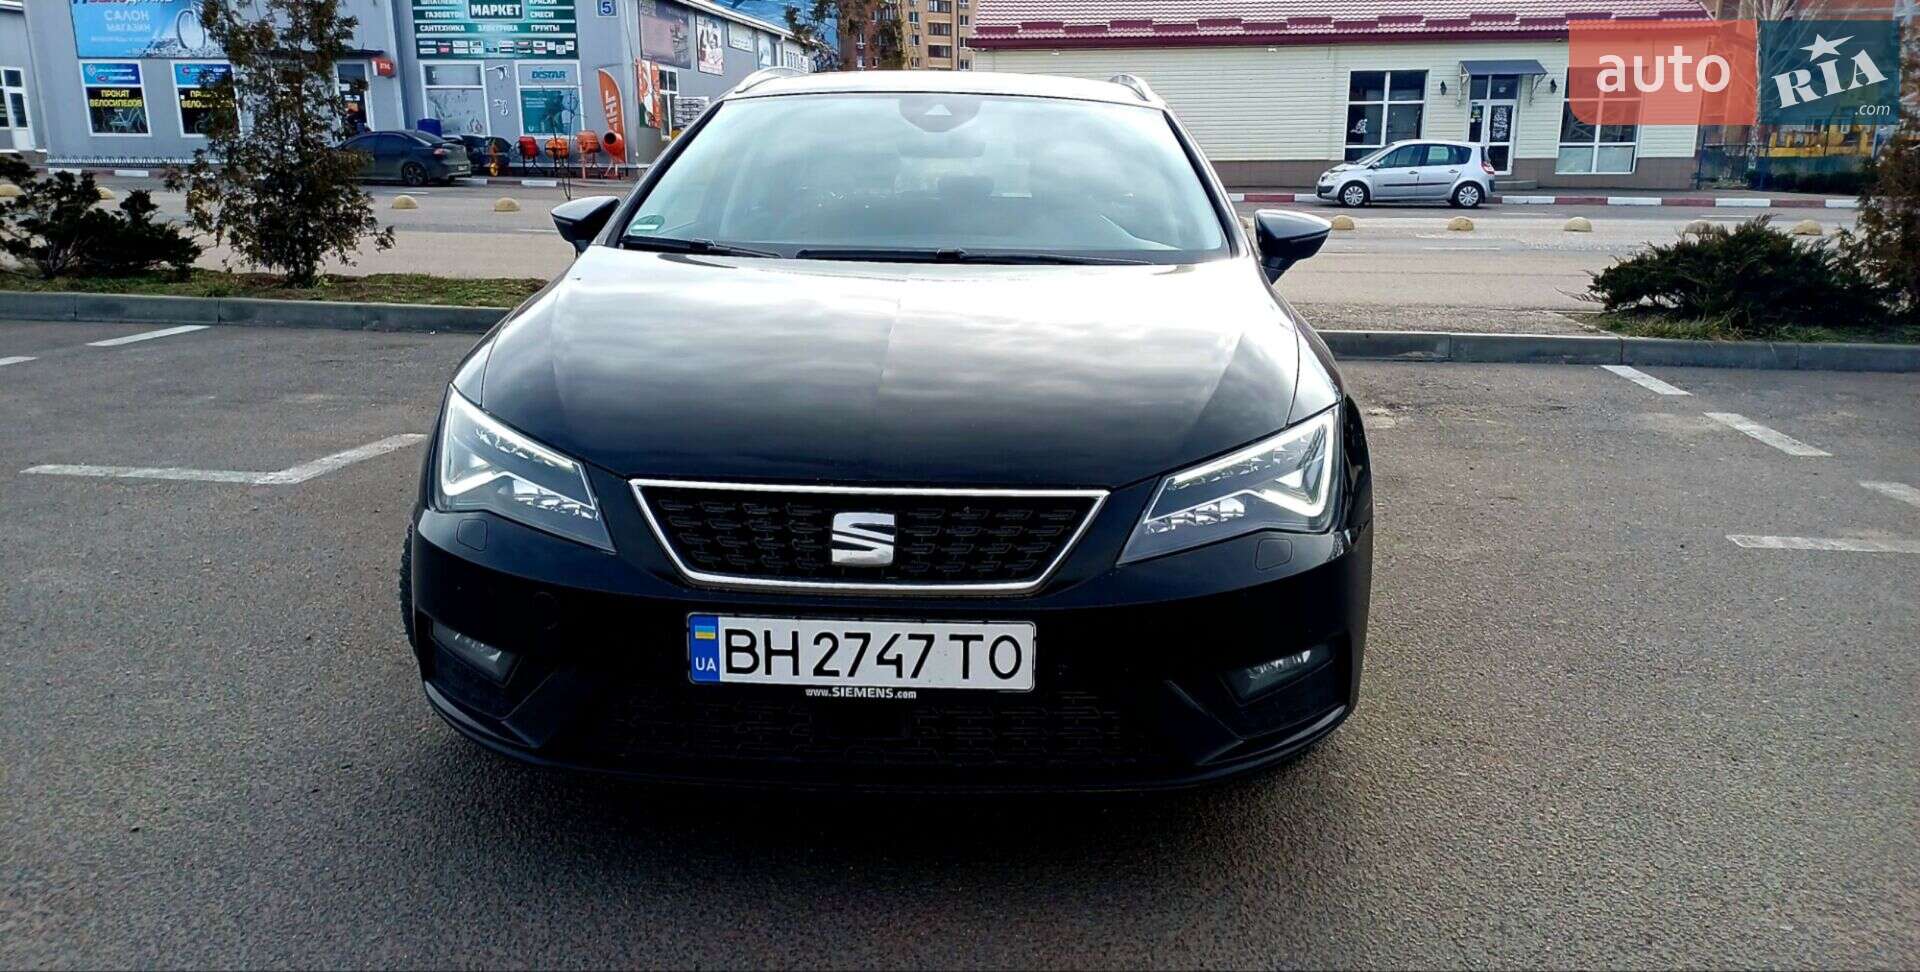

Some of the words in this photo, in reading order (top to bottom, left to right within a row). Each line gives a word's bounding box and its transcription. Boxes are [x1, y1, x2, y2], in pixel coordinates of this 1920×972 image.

[470, 4, 521, 16] МАРКЕТ
[603, 0, 612, 14] 5
[104, 10, 150, 21] САЛОН
[106, 23, 151, 32] МАГАЗИН
[531, 24, 560, 32] ГРУНТЫ
[101, 89, 130, 97] ПРОКАТ
[89, 99, 143, 107] ВЕЛОСИПЕДОВ
[724, 628, 800, 677] BH
[812, 631, 936, 679] 2747
[949, 633, 1023, 680] TO
[695, 657, 716, 672] UA
[805, 686, 917, 699] www.SIEMENS.com
